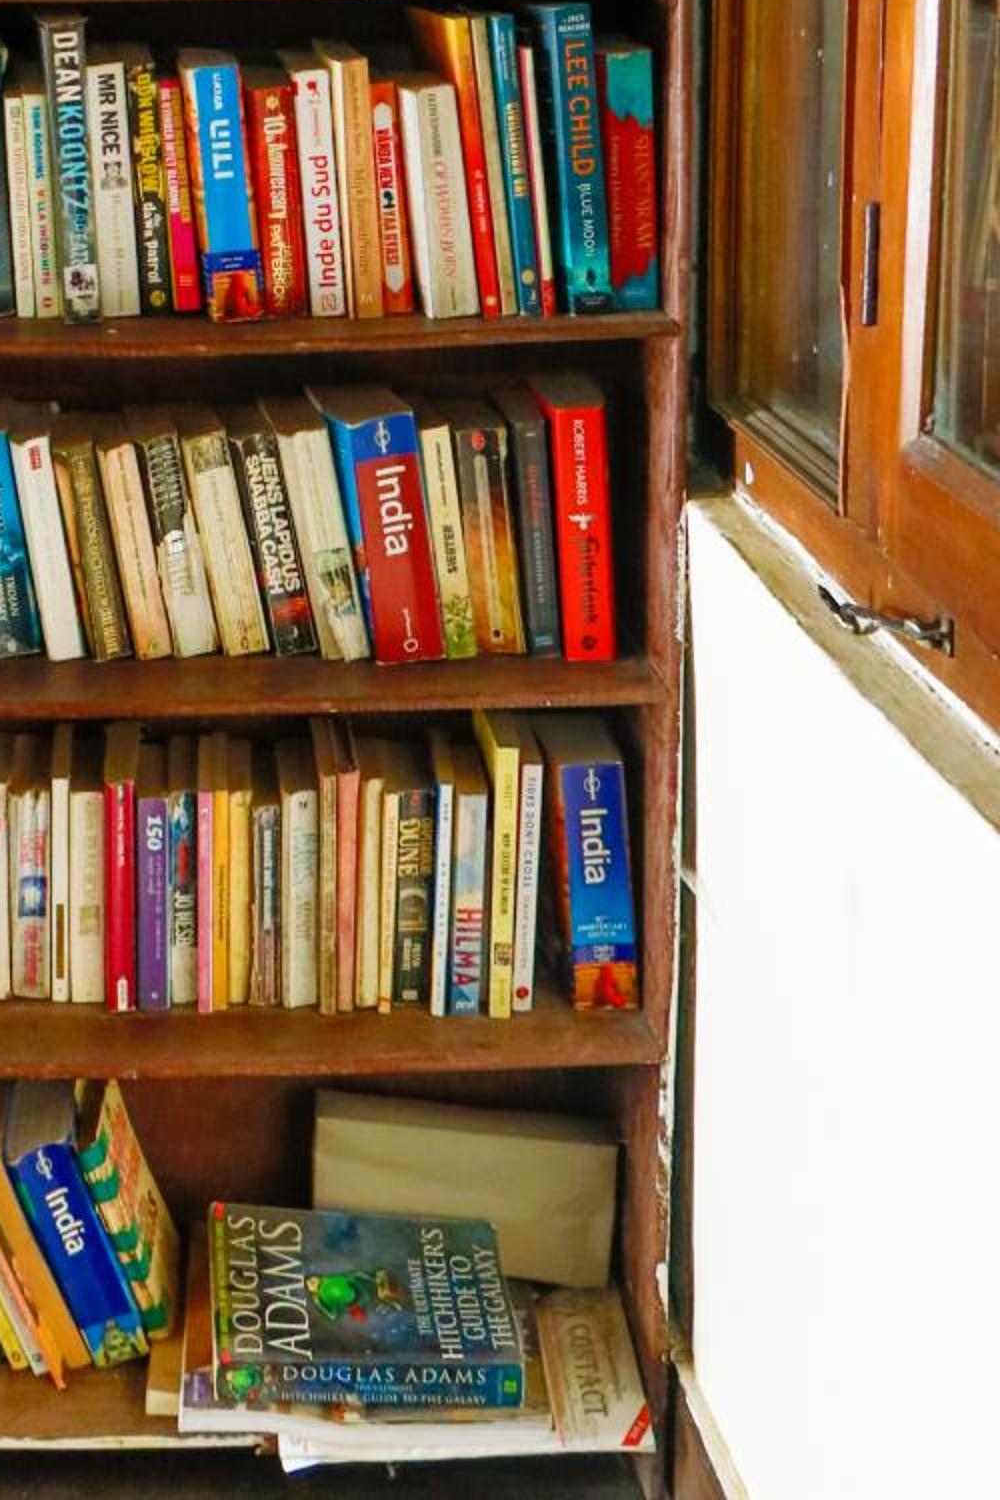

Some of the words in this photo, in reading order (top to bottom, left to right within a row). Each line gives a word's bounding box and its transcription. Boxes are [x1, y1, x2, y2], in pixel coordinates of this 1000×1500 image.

[52, 31, 80, 100] DEAN
[97, 73, 117, 104] MR
[136, 73, 154, 107] DON
[564, 41, 589, 91] LEE
[58, 105, 88, 214] KOONTZ
[102, 111, 121, 155] NICE
[138, 110, 160, 194] WINSLOW
[210, 119, 233, 179] הודו
[569, 95, 595, 177] CHILD
[267, 142, 287, 219] Anniversary
[310, 155, 330, 197] Sud
[577, 183, 592, 216] BLUE
[632, 135, 652, 250] SHANTARAM
[314, 204, 332, 233] du
[382, 208, 395, 230] YAA
[582, 219, 595, 258] MOON
[268, 224, 284, 307] PATTERSON
[318, 239, 338, 288] Inde
[572, 420, 585, 462] ROBERT
[375, 466, 414, 556] India
[575, 466, 588, 505] HARRIS
[244, 455, 269, 541] SNABBA
[260, 540, 282, 596] CASH
[258, 452, 282, 504] JENS
[270, 506, 301, 592] LAPIDUS
[5, 576, 18, 617] TROJAN
[146, 815, 162, 851] 150
[398, 818, 420, 878] DUNE
[580, 808, 610, 885] India
[522, 850, 533, 888] CROSS
[175, 890, 192, 908] JO
[455, 908, 483, 987] HILMA
[46, 1187, 86, 1256] India
[228, 1214, 263, 1354] DOUGLAS
[258, 1220, 312, 1361] ADAMS
[421, 1227, 464, 1360] HITCHHIKER'S
[450, 1255, 473, 1282] TO
[472, 1243, 505, 1313] GALAXY
[454, 1286, 486, 1341] GUIDE
[487, 1315, 515, 1349] THE
[283, 1366, 395, 1382] DOUGLAS
[405, 1368, 487, 1385] ADAMS
